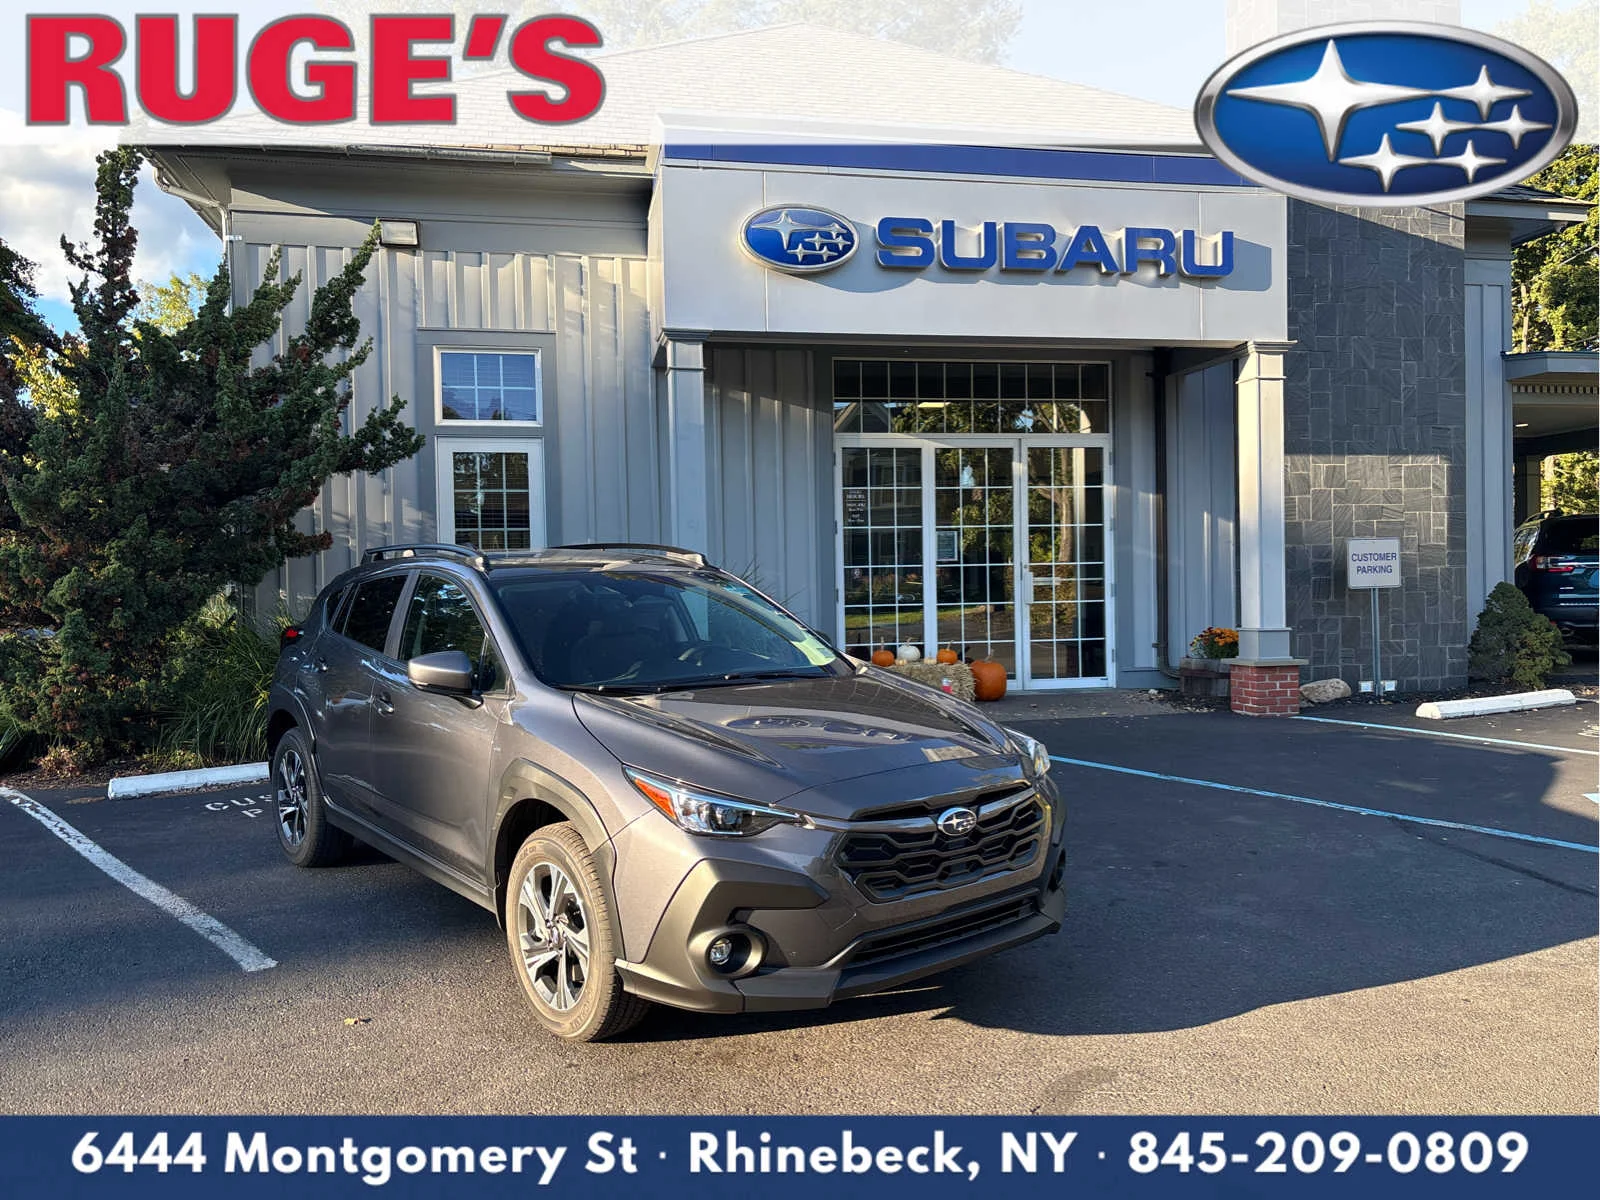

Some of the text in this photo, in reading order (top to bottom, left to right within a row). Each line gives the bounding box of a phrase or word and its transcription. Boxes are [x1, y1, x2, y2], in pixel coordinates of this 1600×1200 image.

[876, 216, 1235, 277] SUBARU
[1351, 552, 1397, 562] CUSTOMER
[1356, 564, 1393, 575] PARKING
